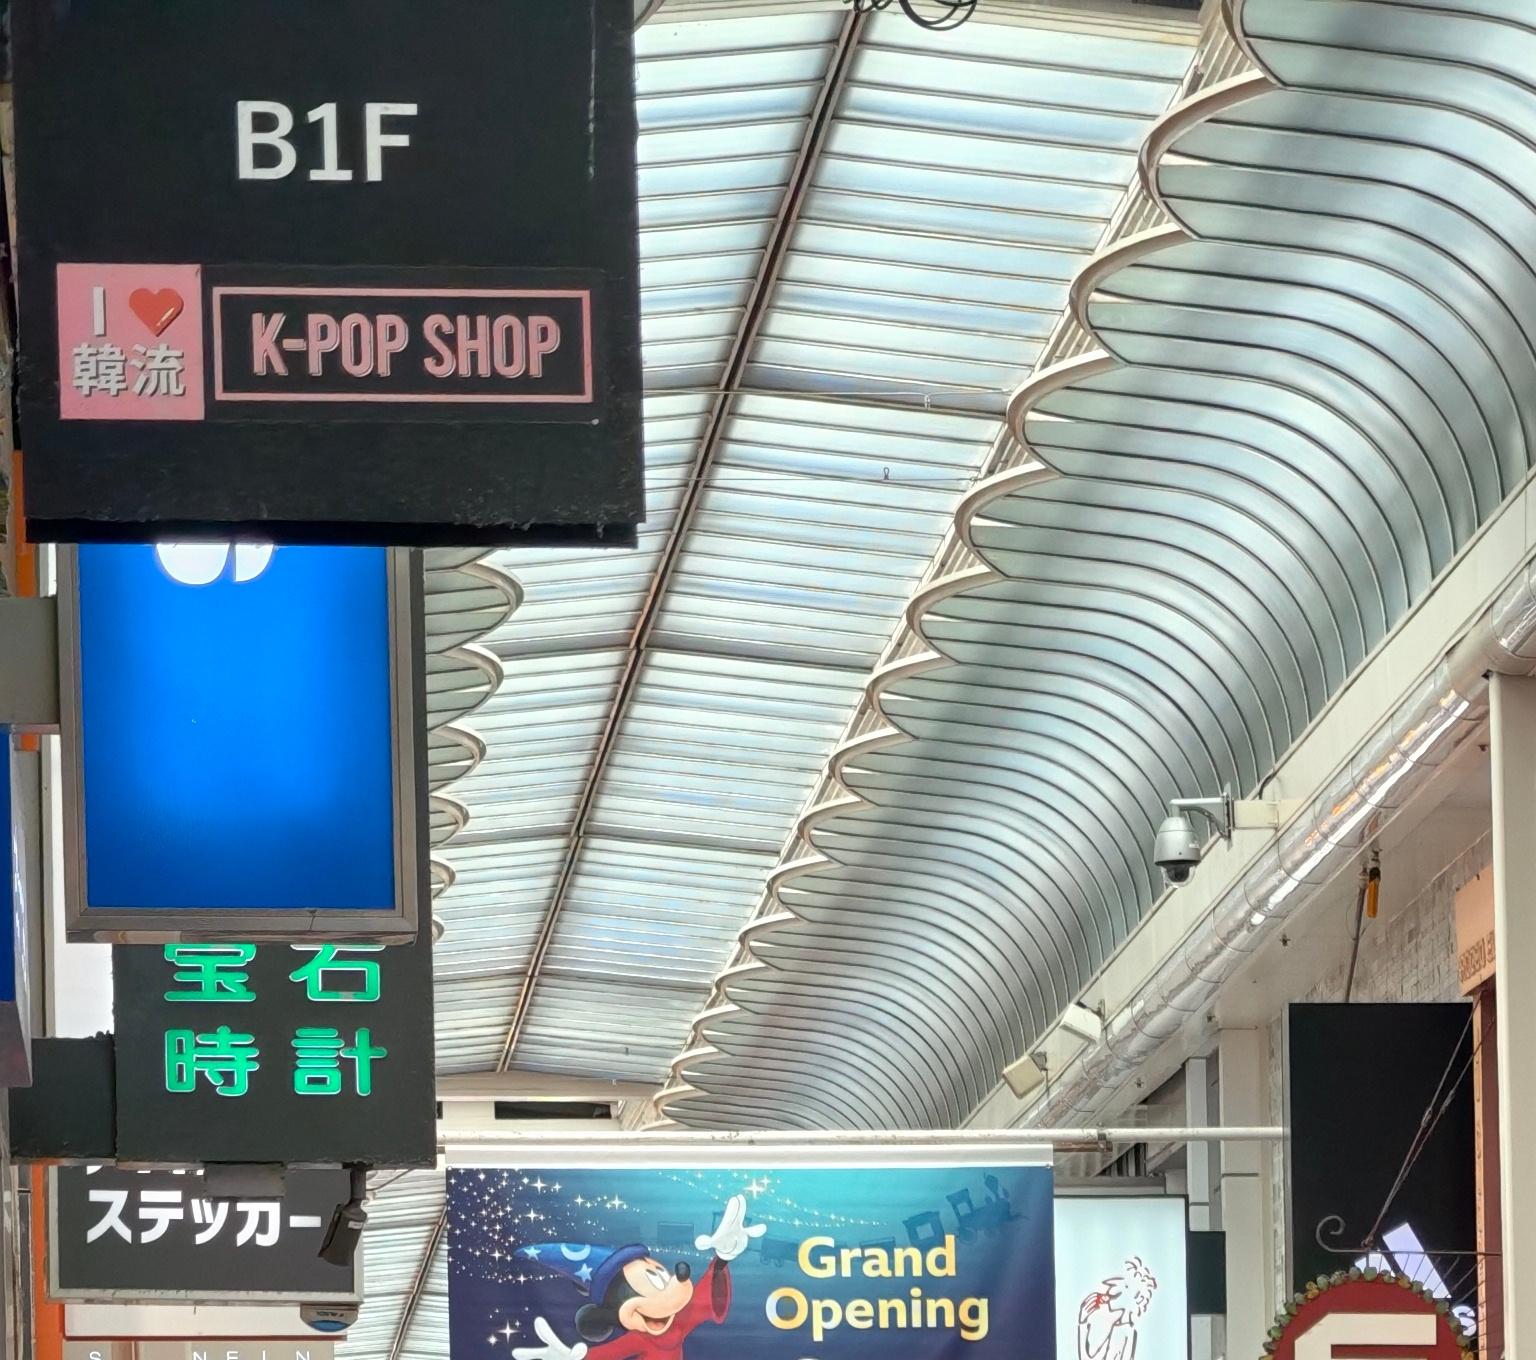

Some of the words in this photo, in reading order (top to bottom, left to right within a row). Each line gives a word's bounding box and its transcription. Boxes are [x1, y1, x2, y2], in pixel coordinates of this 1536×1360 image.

[236, 101, 417, 181] B1F
[93, 287, 105, 335] I
[72, 343, 185, 397] 韓流
[251, 313, 409, 377] K-POP
[423, 314, 561, 379] SHOP
[164, 944, 386, 1002] 宝石
[165, 1026, 388, 1096] 時計
[87, 1190, 321, 1247] ステッカー
[797, 1235, 957, 1278] Grand
[765, 1286, 990, 1341] Opening
